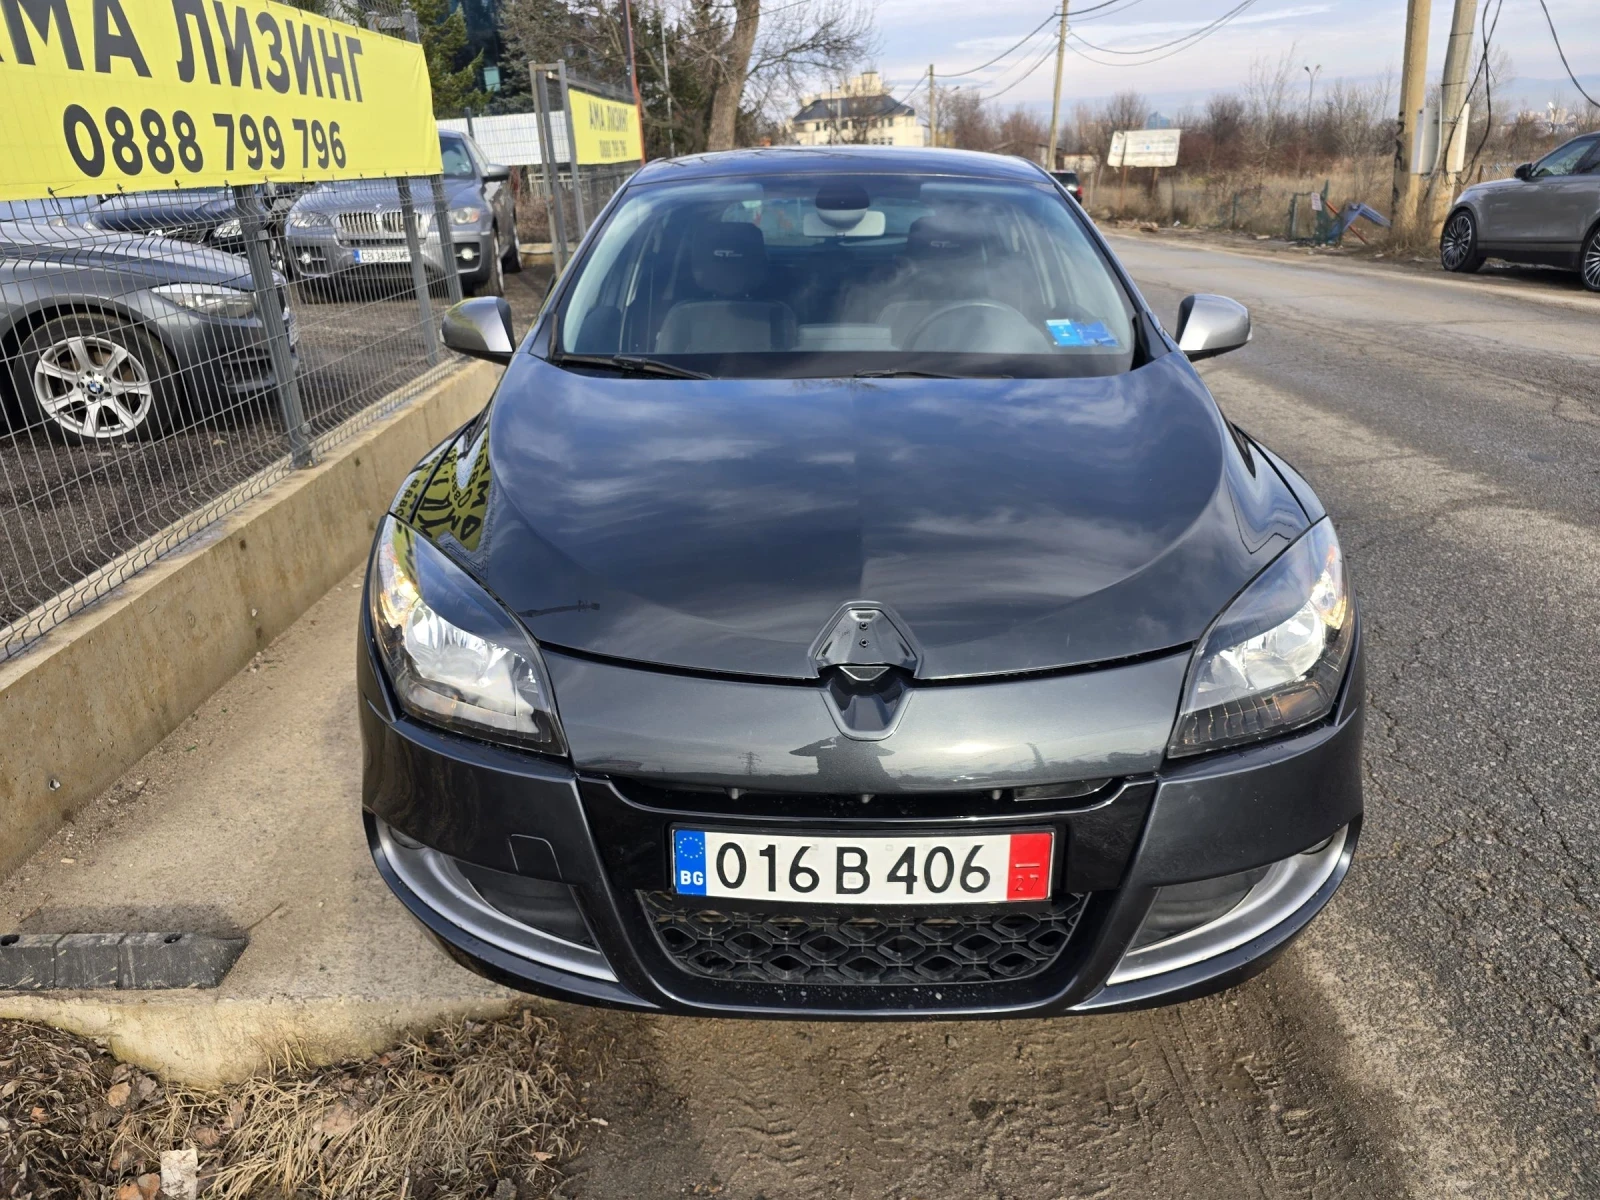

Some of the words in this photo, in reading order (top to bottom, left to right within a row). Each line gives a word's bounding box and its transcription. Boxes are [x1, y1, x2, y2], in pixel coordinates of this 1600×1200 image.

[0, 0, 153, 78] МА
[173, 0, 364, 103] ЛИЗИНГ
[62, 103, 204, 178] 0888
[212, 112, 286, 171] 799
[292, 118, 347, 170] 796
[680, 870, 704, 886] BG
[715, 841, 820, 893] 016
[835, 846, 871, 895] B
[886, 844, 991, 895] 406
